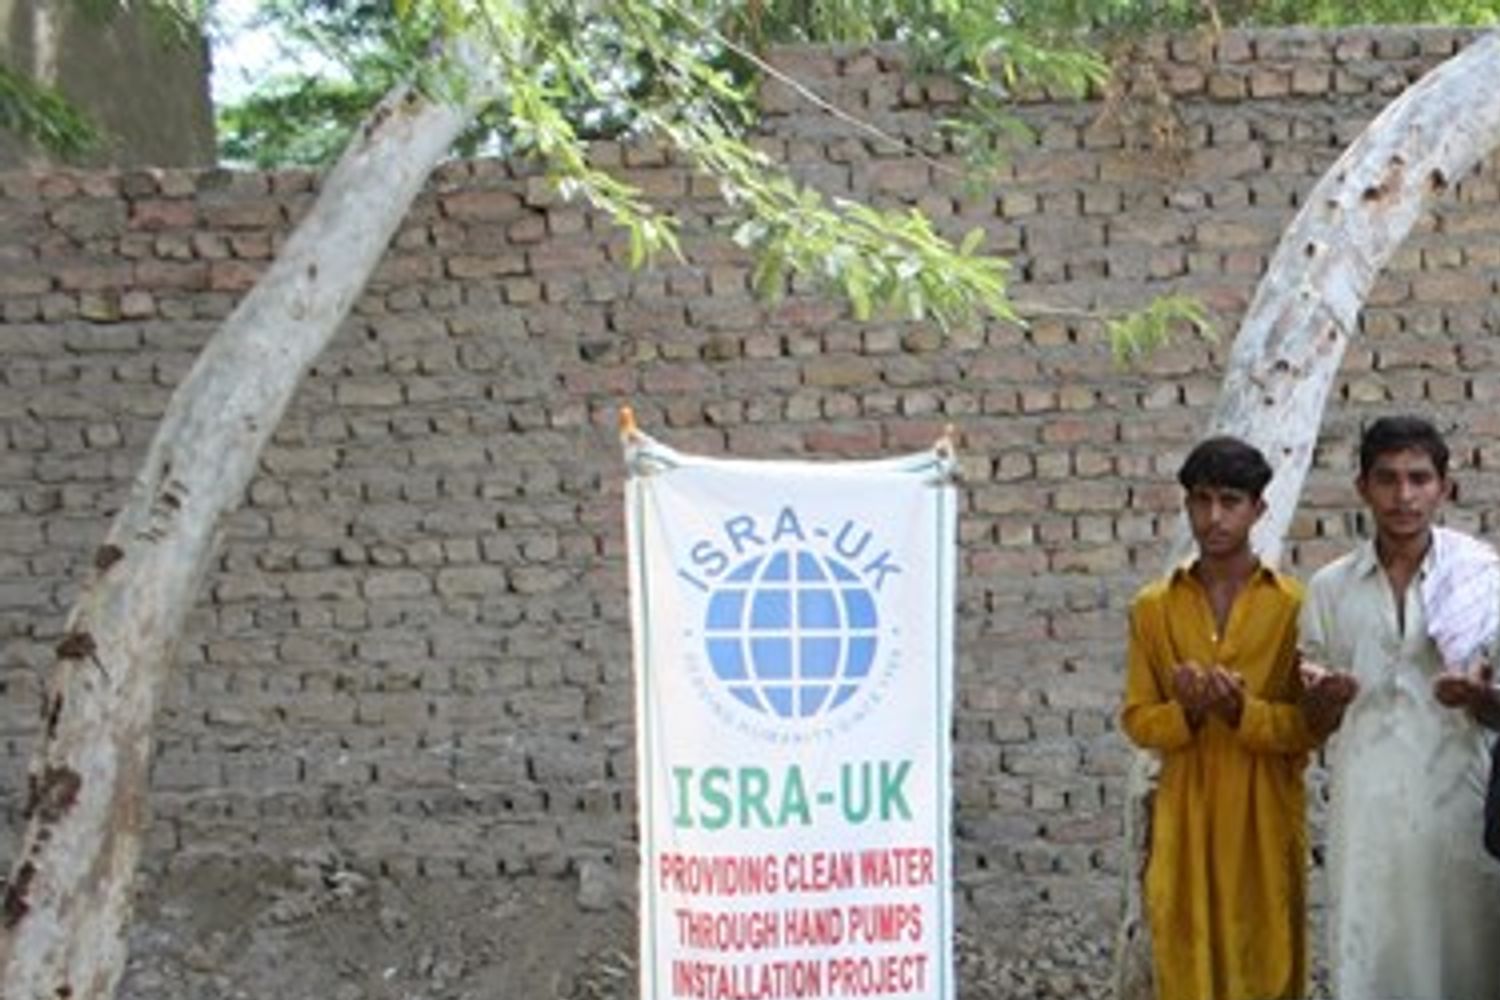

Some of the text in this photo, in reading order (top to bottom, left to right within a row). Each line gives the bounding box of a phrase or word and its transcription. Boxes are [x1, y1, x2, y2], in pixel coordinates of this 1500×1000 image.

[678, 506, 902, 592] ISRA-UK
[672, 760, 913, 830] ISRA-UK
[659, 848, 934, 895] PROVIDING CLEAN WATER
[675, 903, 922, 952] THROUGH HAND PUMPS
[827, 953, 928, 998] PROJECT
